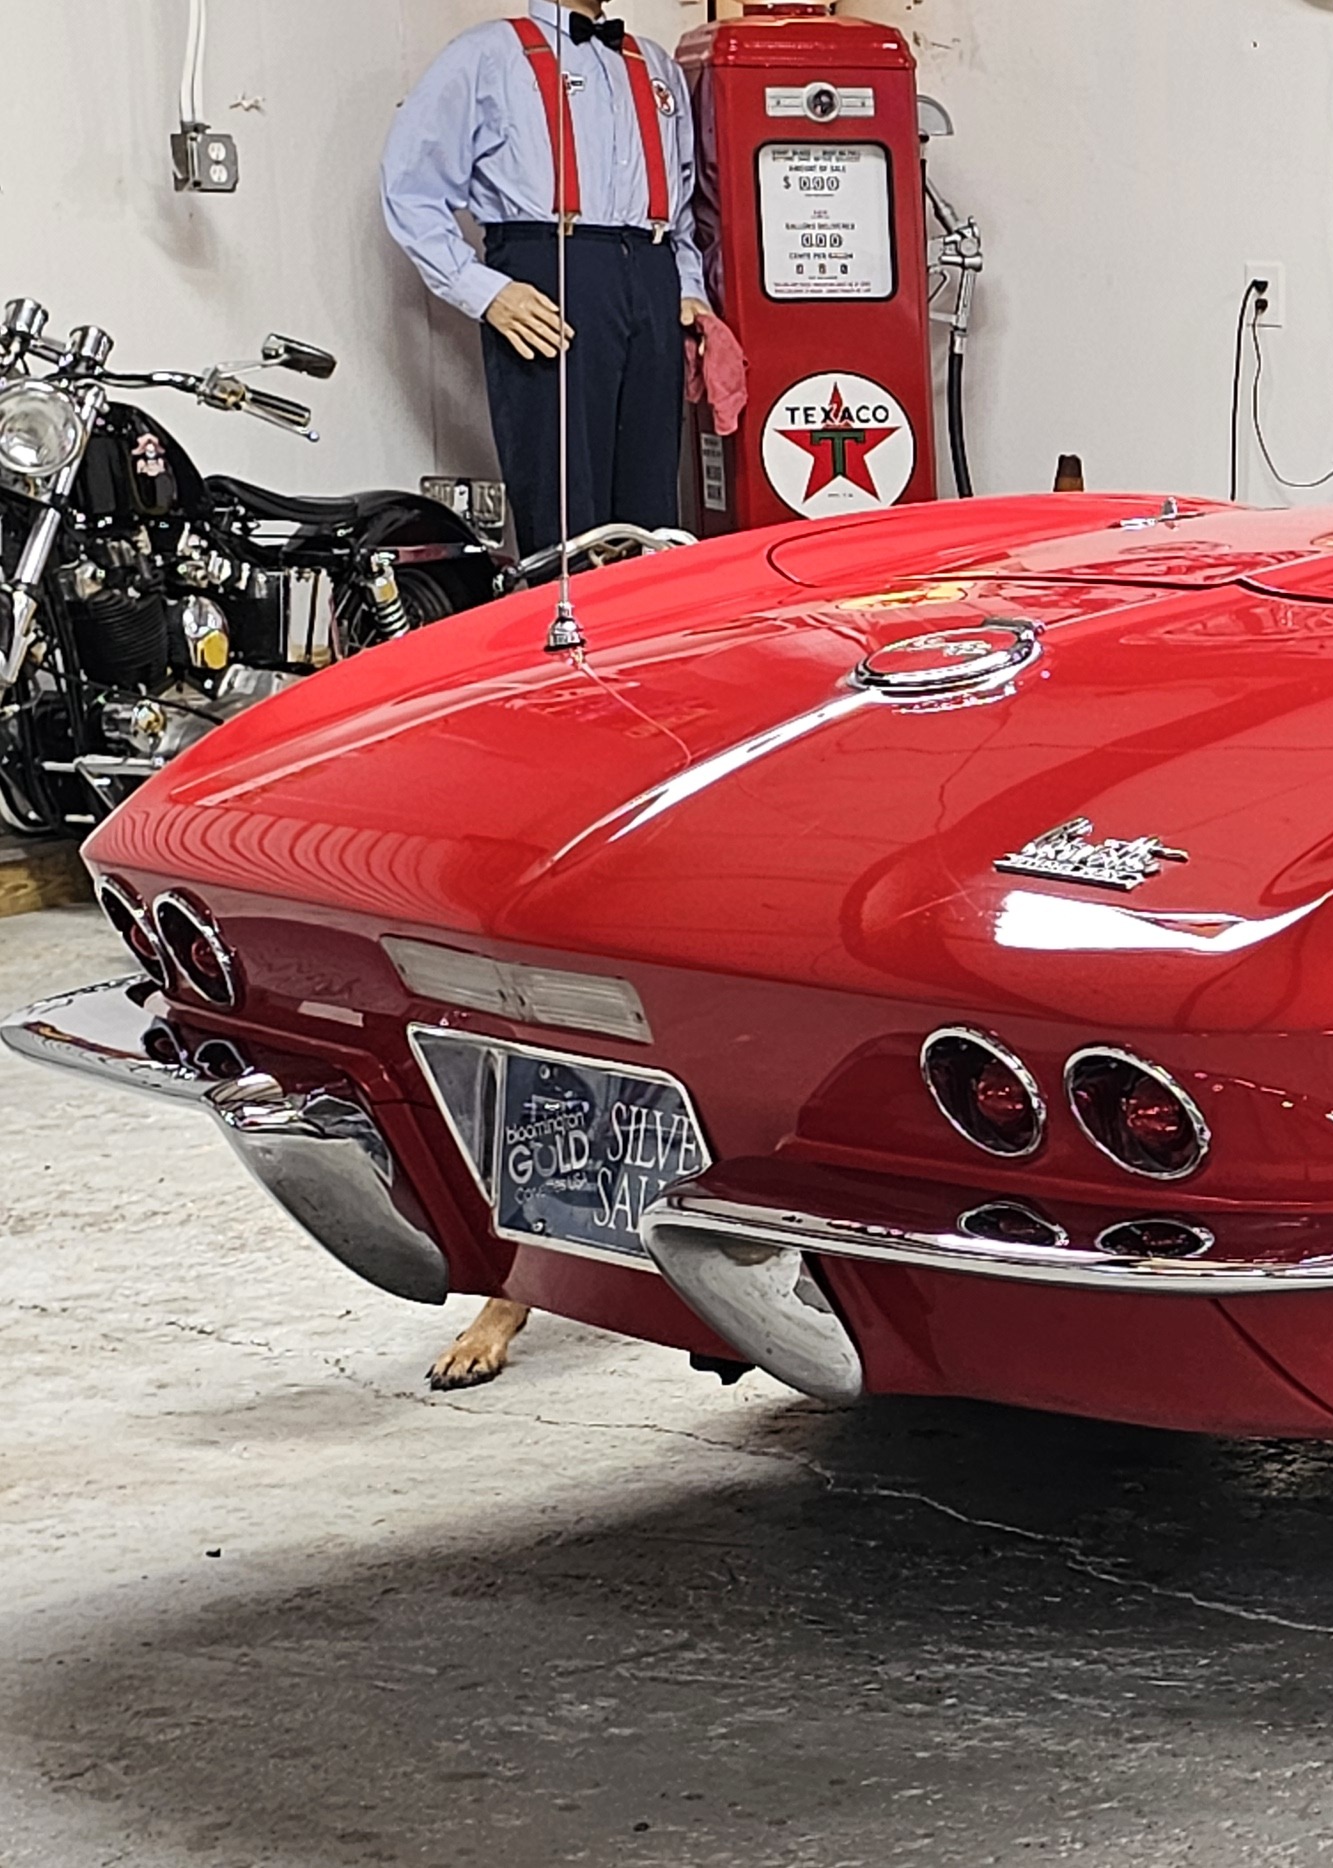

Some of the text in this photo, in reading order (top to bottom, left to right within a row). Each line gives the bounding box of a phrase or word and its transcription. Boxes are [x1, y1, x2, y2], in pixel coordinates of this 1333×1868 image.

[785, 405, 889, 425] TEXACO
[508, 1129, 590, 1185] GOLD
[594, 1167, 667, 1233] SAL
